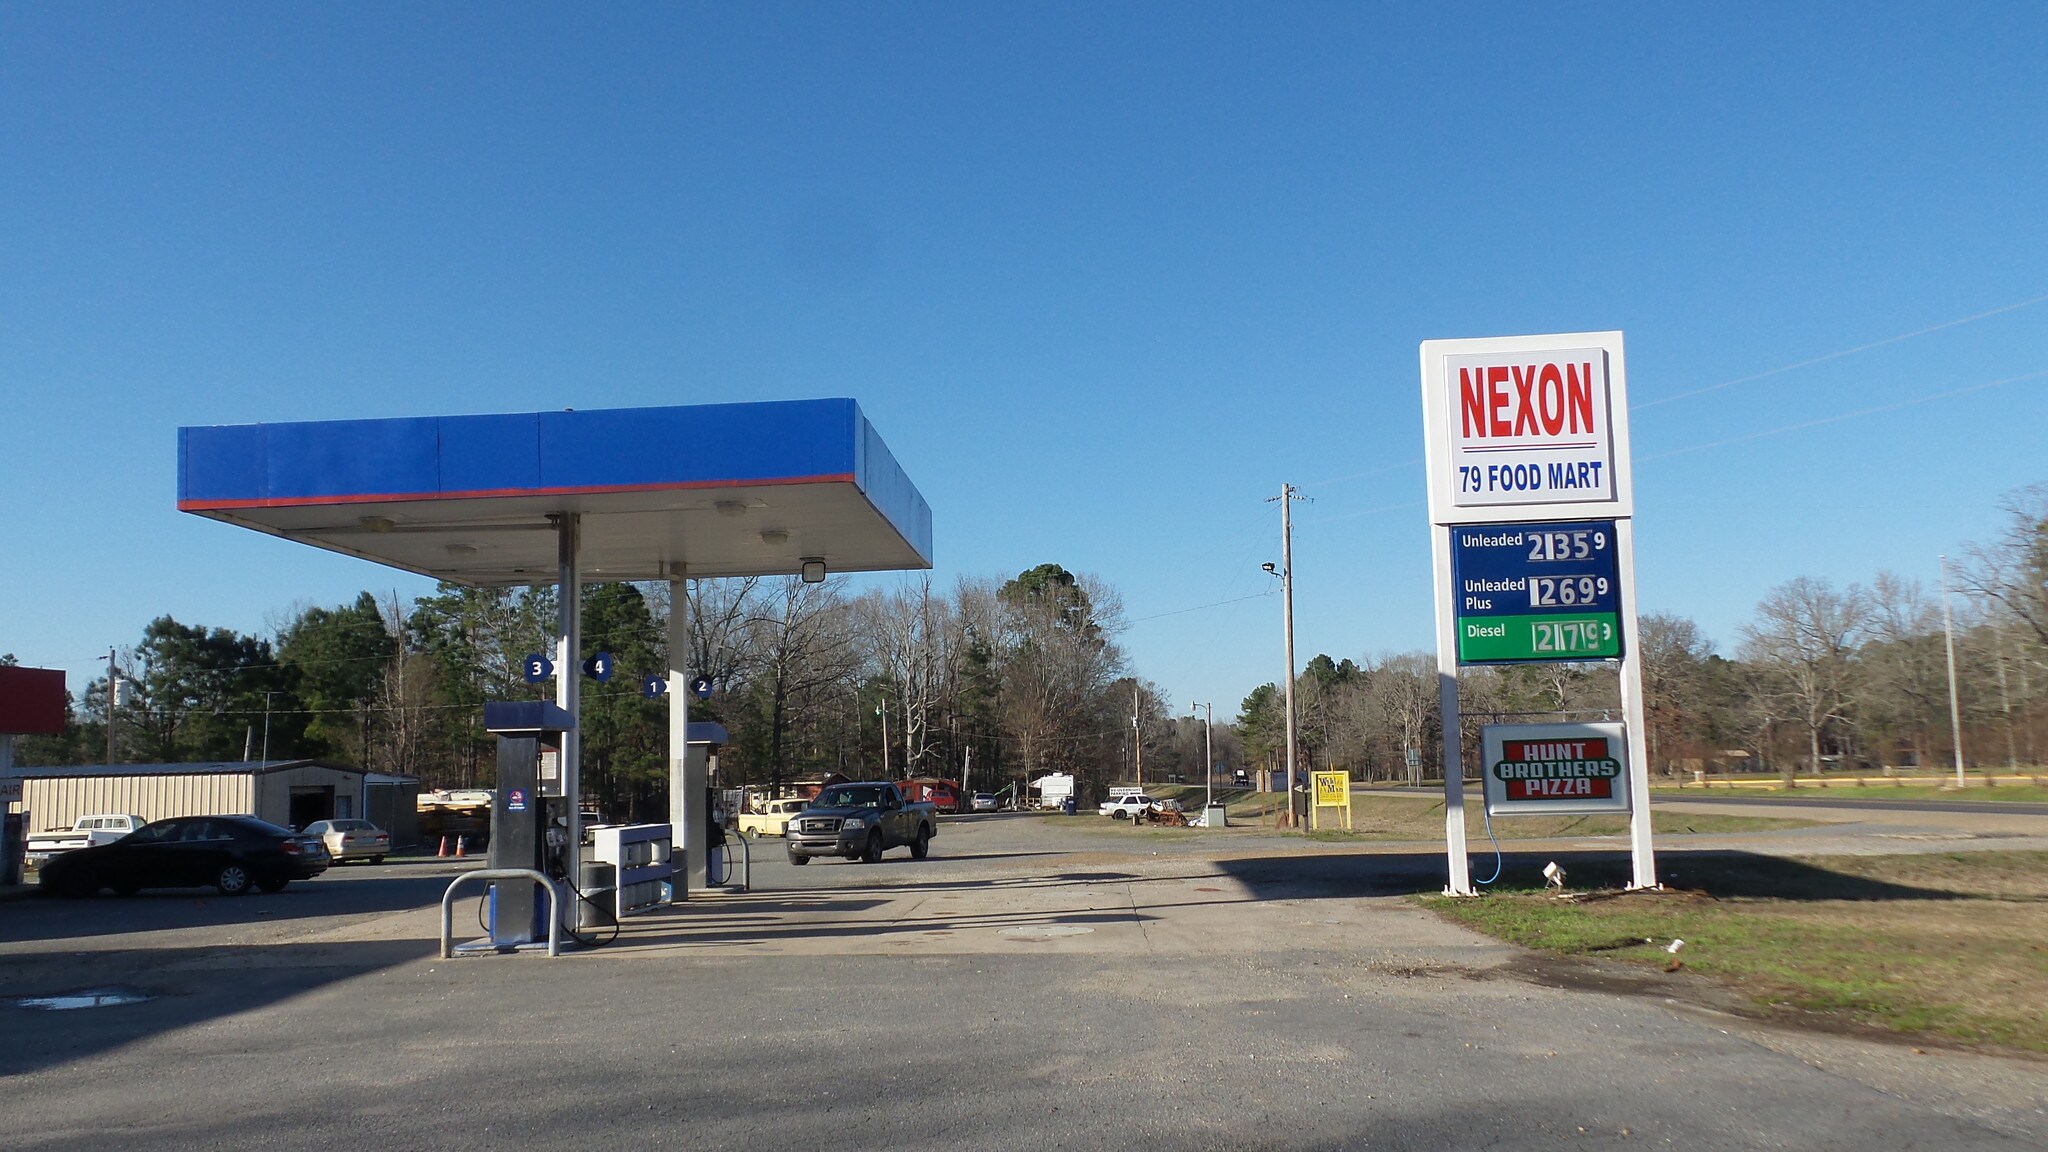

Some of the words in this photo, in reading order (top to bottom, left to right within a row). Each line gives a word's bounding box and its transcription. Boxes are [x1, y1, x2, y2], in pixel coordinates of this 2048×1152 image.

[1459, 362, 1595, 439] NEXON
[1459, 466, 1481, 493] 79
[1488, 464, 1542, 492] FOOD
[1548, 461, 1602, 490] MART
[1462, 533, 1523, 548] Unleaded
[1465, 577, 1526, 592] Unleaded
[1465, 597, 1492, 610] Plus
[1467, 623, 1505, 637] Diesel
[532, 661, 542, 676] 3
[594, 660, 604, 674] 4
[650, 681, 657, 693] 1
[698, 680, 707, 692] 2
[1523, 743, 1586, 761] HUNT
[1500, 760, 1615, 779] BROTHERS
[0, 784, 20, 796] AIR
[1525, 777, 1591, 796] PIZZA
